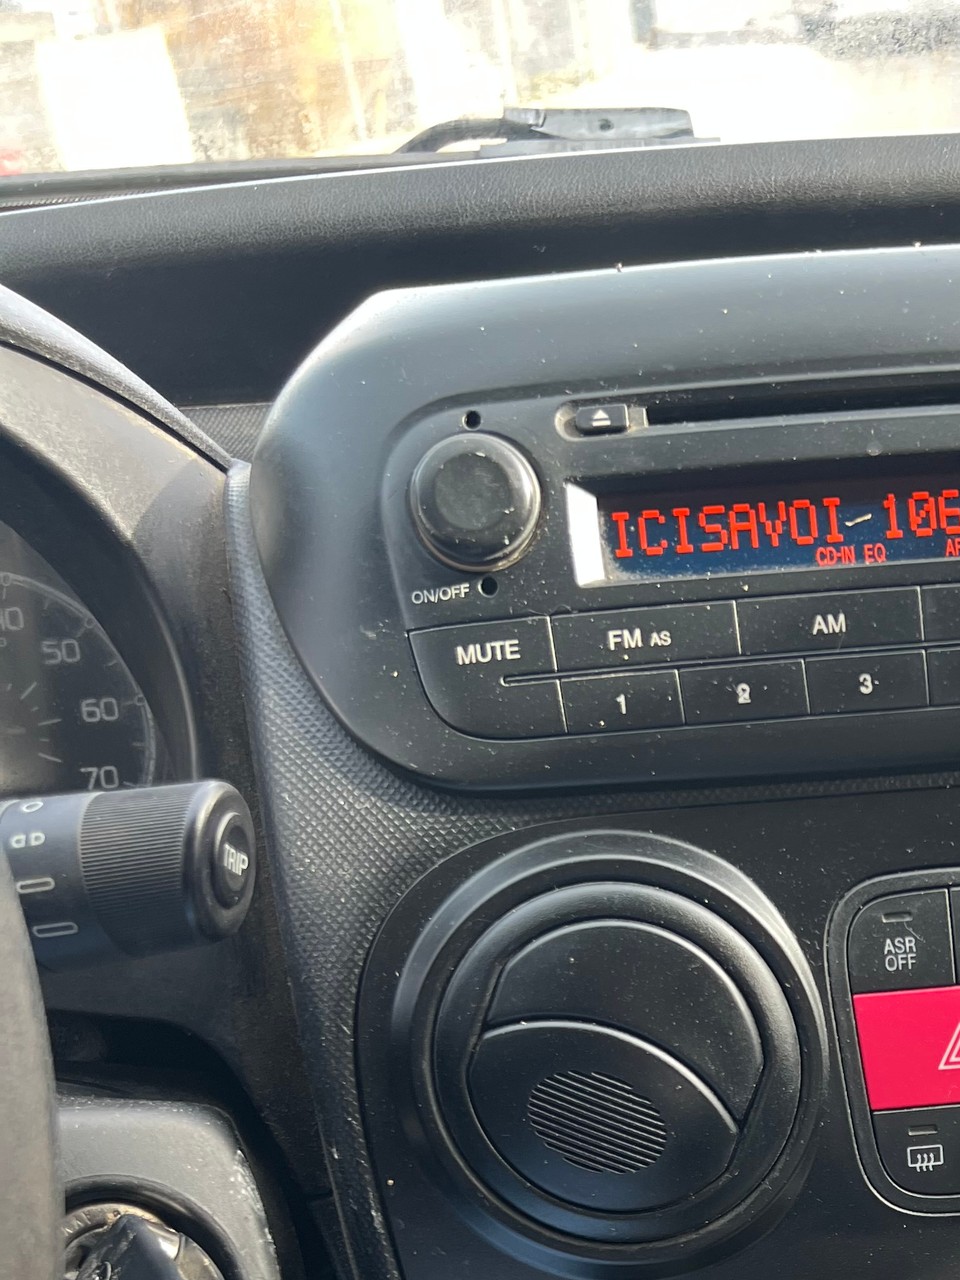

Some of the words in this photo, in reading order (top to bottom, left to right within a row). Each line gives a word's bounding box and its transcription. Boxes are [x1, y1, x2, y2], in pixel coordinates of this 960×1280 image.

[611, 497, 844, 559] ICISAVOI
[863, 543, 887, 565] EQ
[411, 583, 470, 605] ON/OFF
[812, 613, 847, 635] AM
[607, 629, 642, 650] FM
[650, 631, 672, 648] AS
[41, 638, 81, 665] 50
[455, 639, 521, 666] MUTE
[736, 682, 752, 705] 2
[858, 673, 874, 695] 3
[81, 697, 119, 723] 60
[616, 694, 627, 715] 1
[80, 765, 119, 790] 70
[222, 842, 249, 876] TRIP
[884, 937, 917, 954] ASR
[885, 954, 917, 972] OFF
